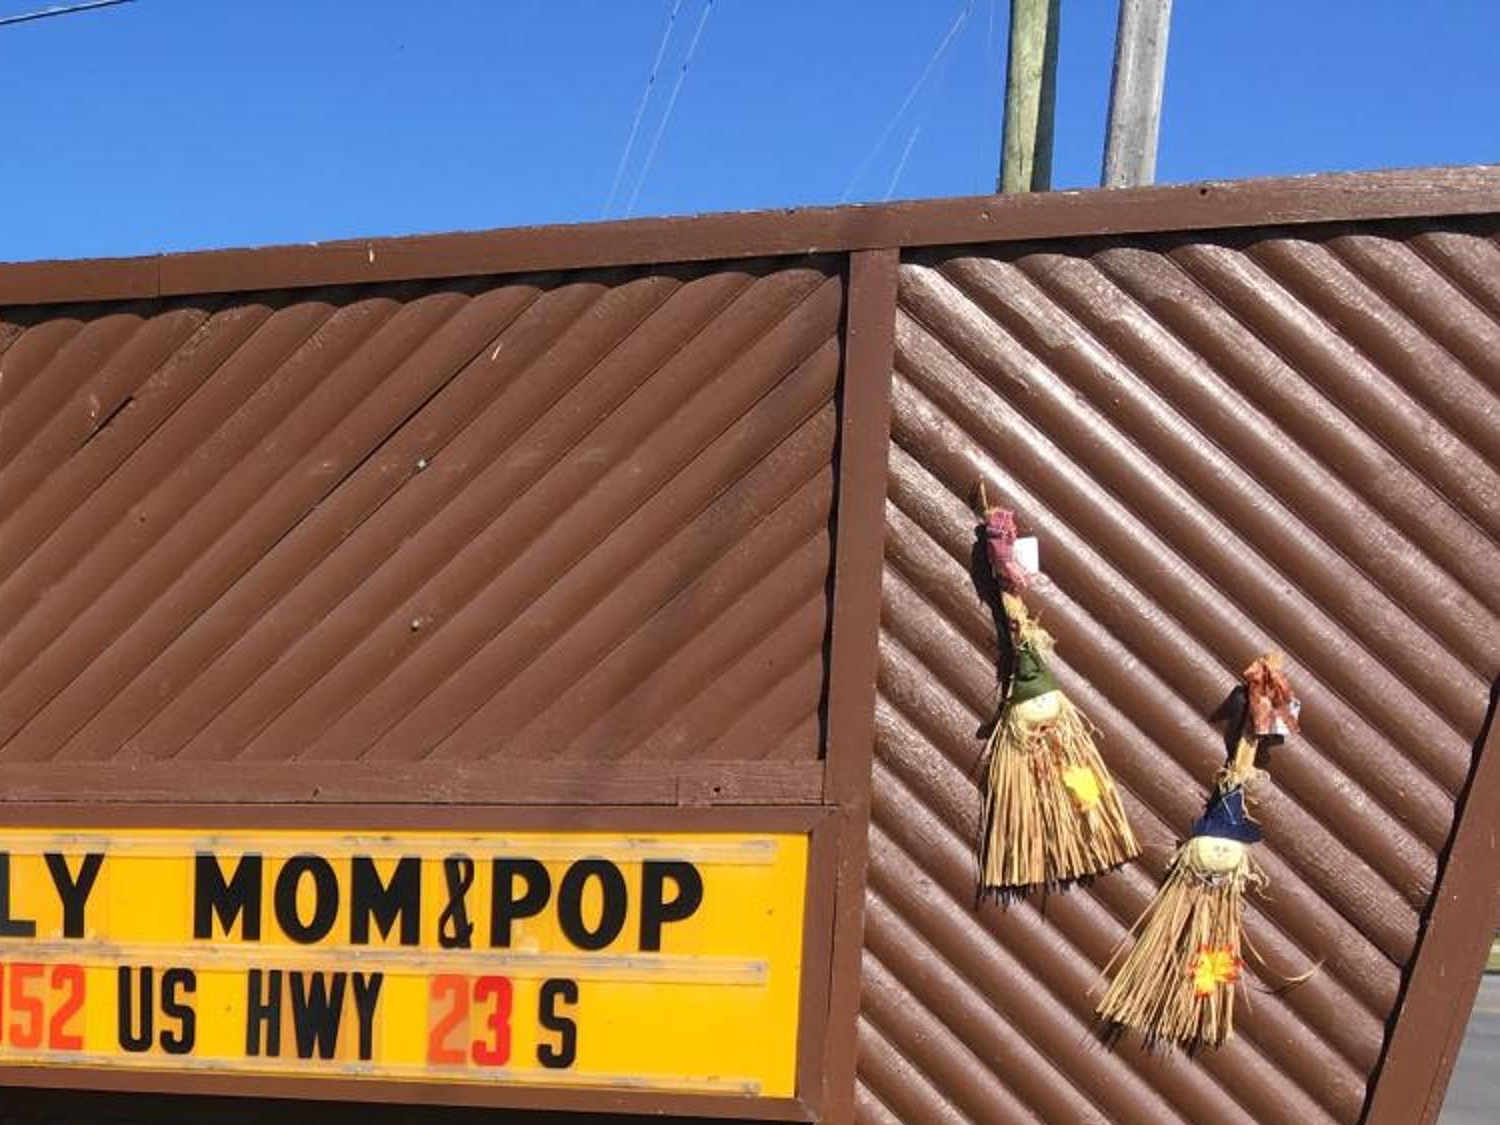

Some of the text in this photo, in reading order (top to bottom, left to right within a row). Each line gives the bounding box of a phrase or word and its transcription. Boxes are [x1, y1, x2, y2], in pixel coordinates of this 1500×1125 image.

[194, 854, 704, 951] MOM&POP
[118, 965, 196, 1055] US
[246, 969, 383, 1060] HWY
[426, 973, 514, 1067] 23
[537, 978, 579, 1069] S
